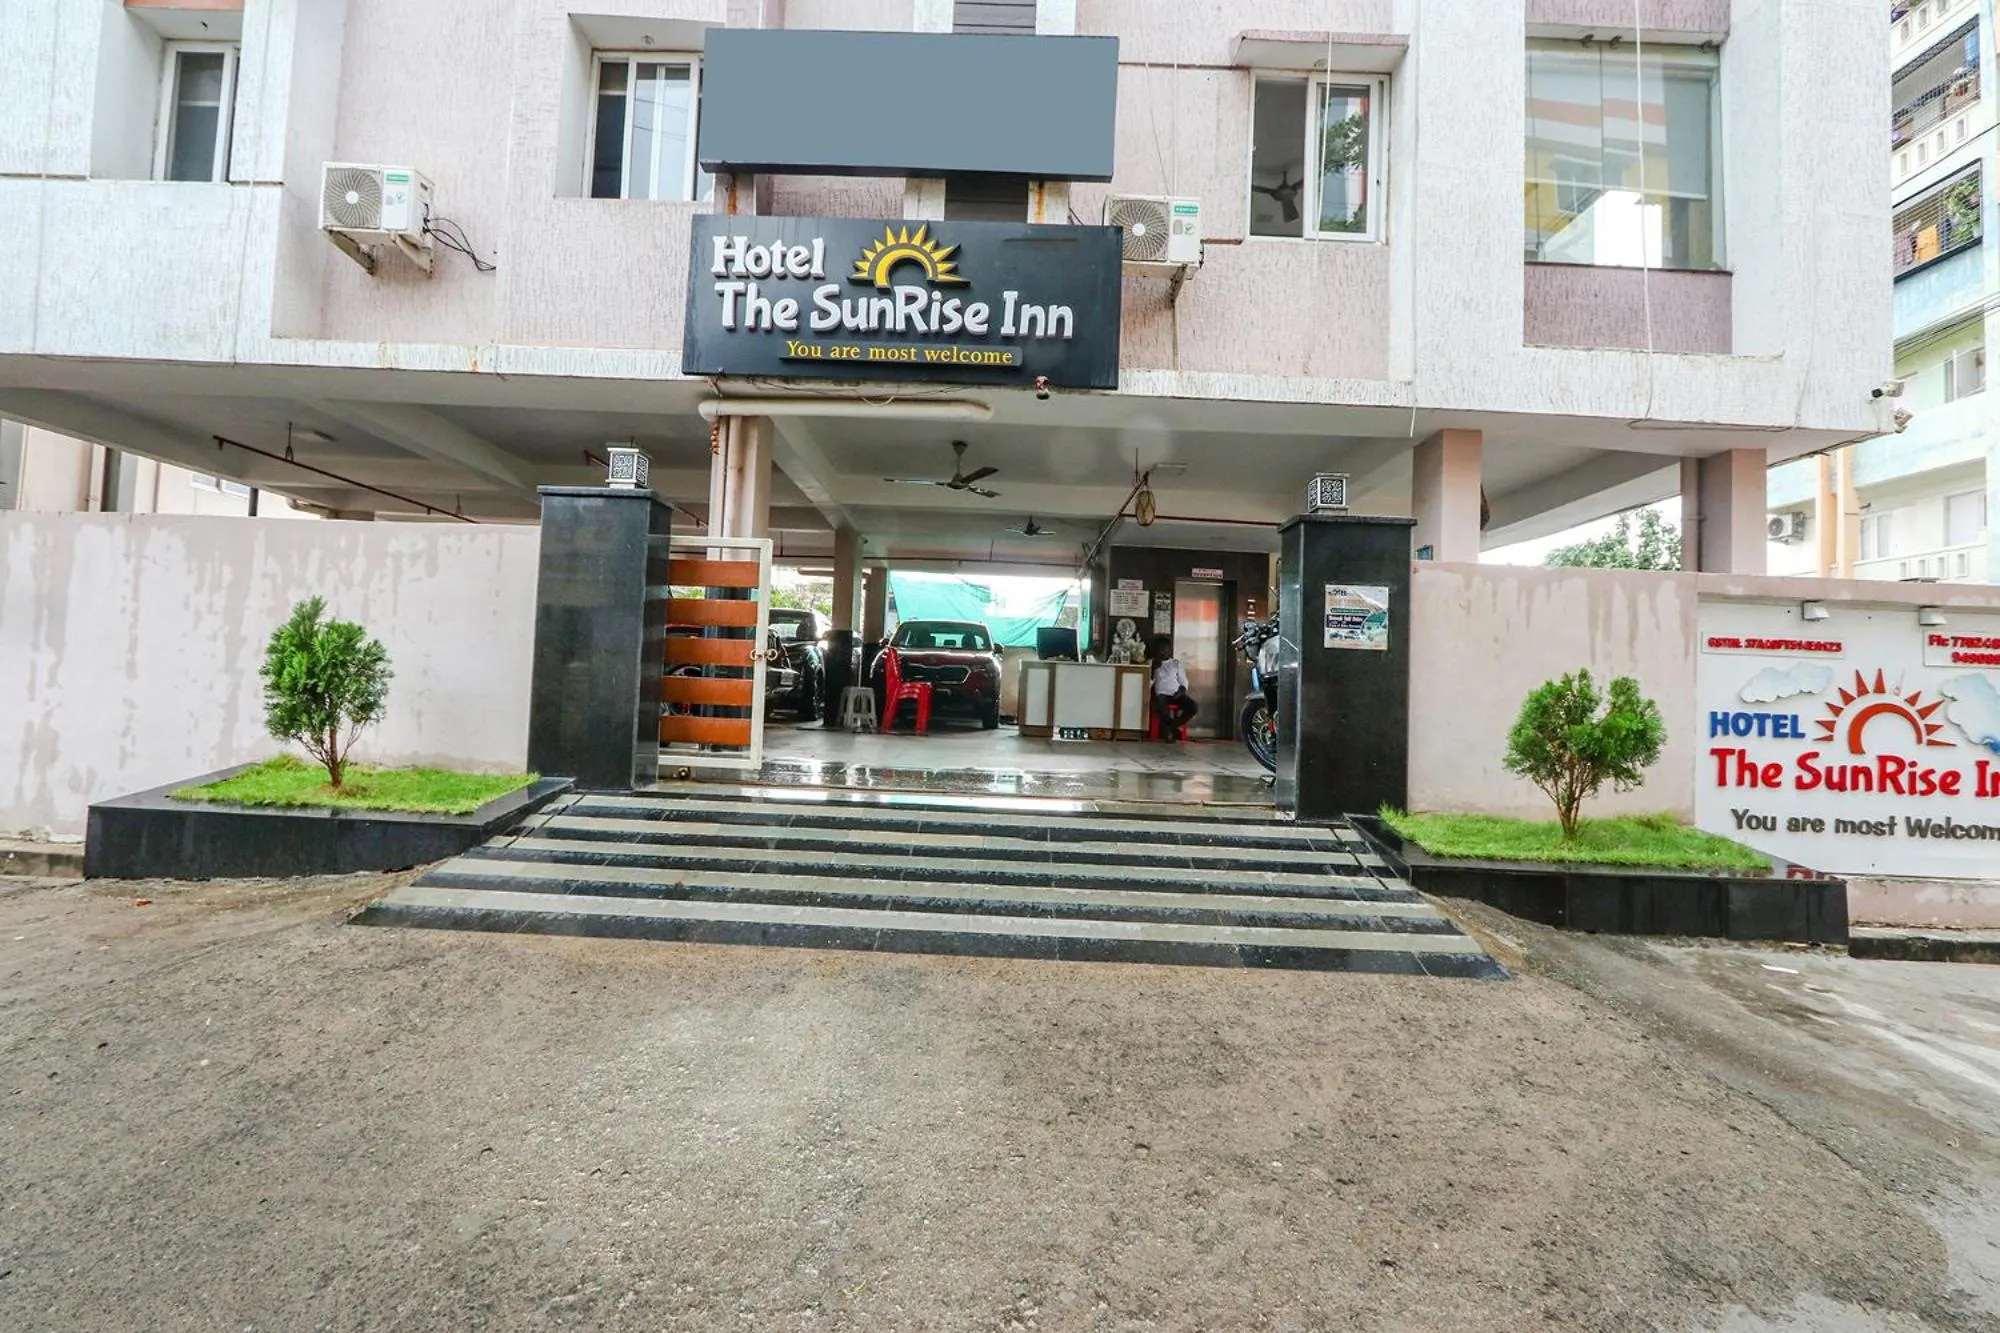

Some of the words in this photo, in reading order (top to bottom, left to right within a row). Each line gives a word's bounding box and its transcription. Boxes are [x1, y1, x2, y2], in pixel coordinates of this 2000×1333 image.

[712, 235, 825, 279] Hotel
[714, 282, 798, 332] The
[810, 284, 989, 334] SunRise
[1001, 290, 1073, 339] Inn
[786, 341, 821, 359] You
[830, 346, 860, 360] are
[868, 346, 917, 362] most
[924, 347, 1013, 364] welcome
[1709, 711, 1805, 739] HOTEL
[1710, 748, 1783, 788] The
[1795, 751, 1961, 797] SunRise
[1731, 809, 1777, 832] You
[1787, 816, 1826, 833] are
[1834, 815, 1898, 837] most
